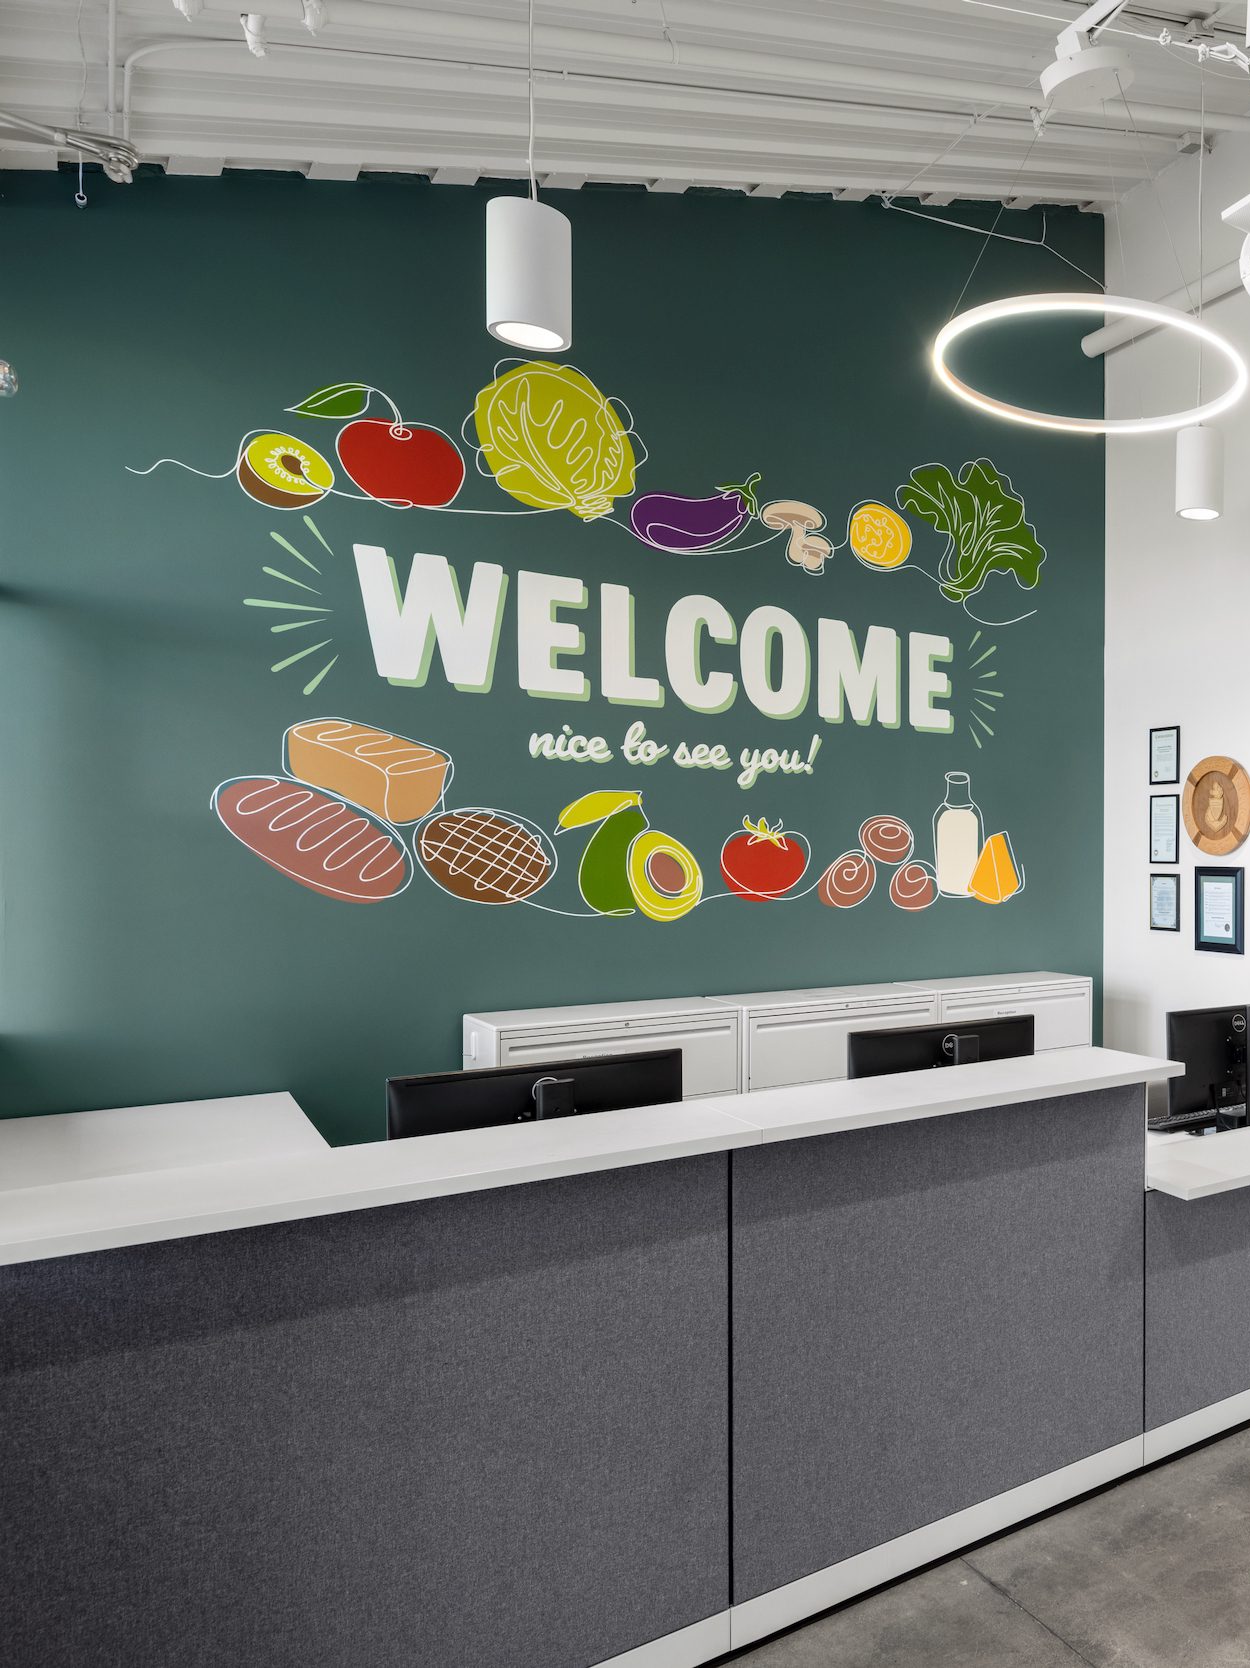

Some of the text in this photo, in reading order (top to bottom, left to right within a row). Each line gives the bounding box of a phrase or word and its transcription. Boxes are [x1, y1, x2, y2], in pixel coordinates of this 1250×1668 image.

[353, 543, 954, 734] WELCOME
[529, 720, 822, 790] nice to see you!
